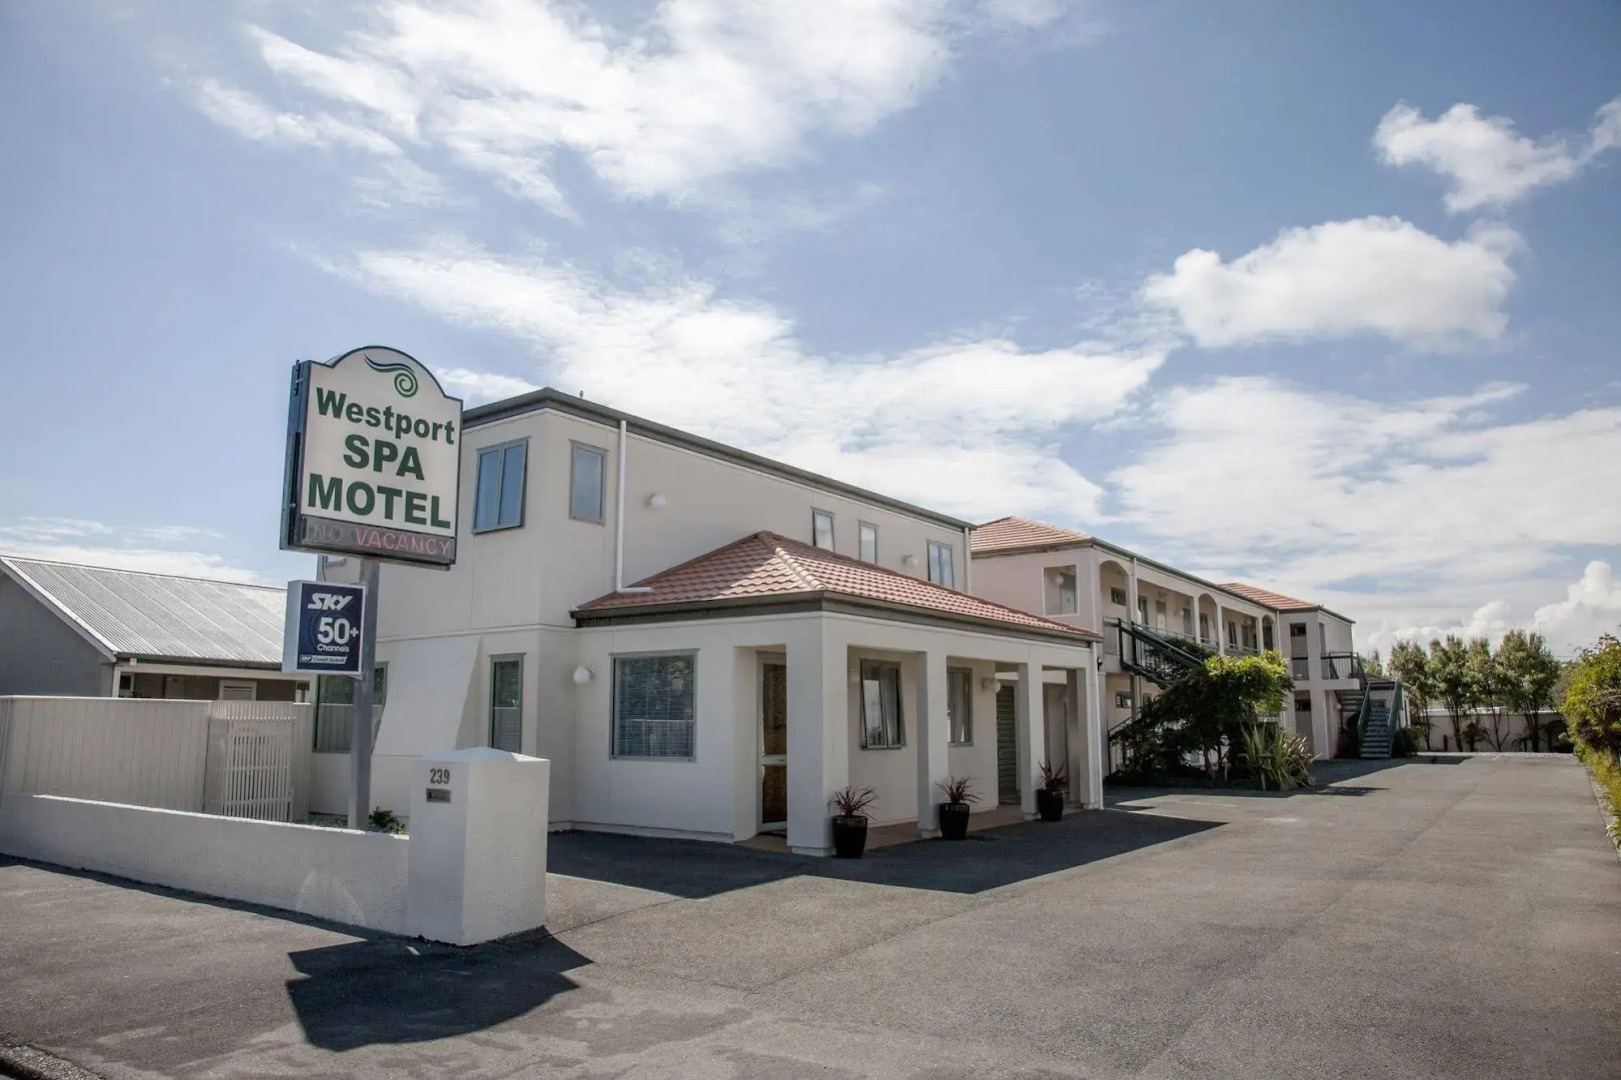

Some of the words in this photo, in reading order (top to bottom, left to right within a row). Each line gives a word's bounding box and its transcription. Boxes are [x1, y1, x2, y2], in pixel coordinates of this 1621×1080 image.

[316, 387, 455, 445] Westport
[343, 434, 425, 481] SPA
[307, 472, 451, 529] MOTEL
[355, 527, 451, 555] VACANCY
[307, 592, 353, 610] SKY
[317, 617, 359, 645] 50+
[317, 643, 350, 653] Channels
[430, 767, 450, 785] 239
